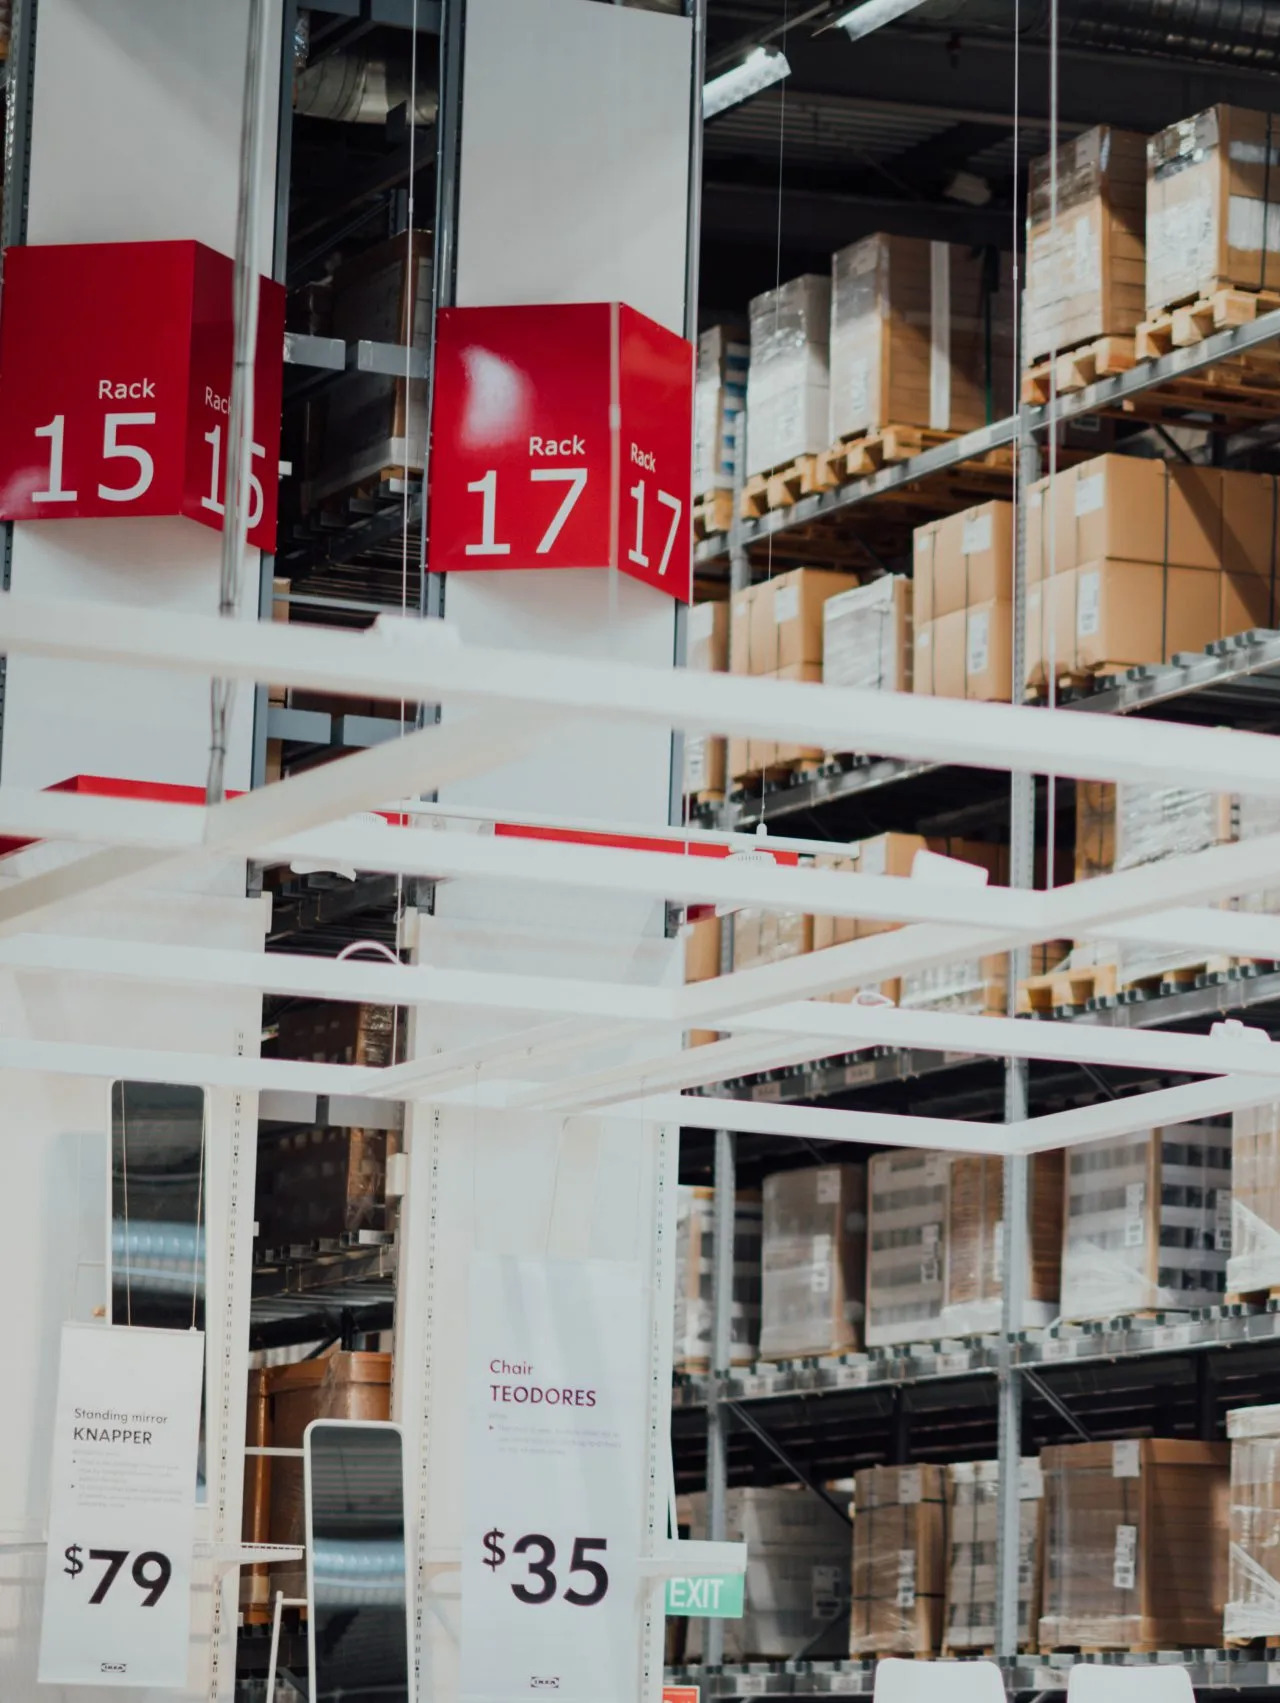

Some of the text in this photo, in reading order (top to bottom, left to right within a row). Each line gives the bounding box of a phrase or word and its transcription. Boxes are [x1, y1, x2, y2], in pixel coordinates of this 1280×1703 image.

[98, 378, 156, 400] Rack
[30, 411, 157, 503] 15
[528, 434, 587, 457] Rack
[630, 441, 657, 474] Rack
[464, 467, 589, 557] 17
[627, 479, 683, 576] 17
[489, 1359, 534, 1376] Chair
[489, 1383, 597, 1408] TEODORES
[74, 1407, 168, 1425] Standing mirror
[72, 1426, 153, 1446] KNAPPER
[63, 1542, 173, 1608] $79
[481, 1526, 610, 1607] $35
[668, 1576, 725, 1610] EXIT
